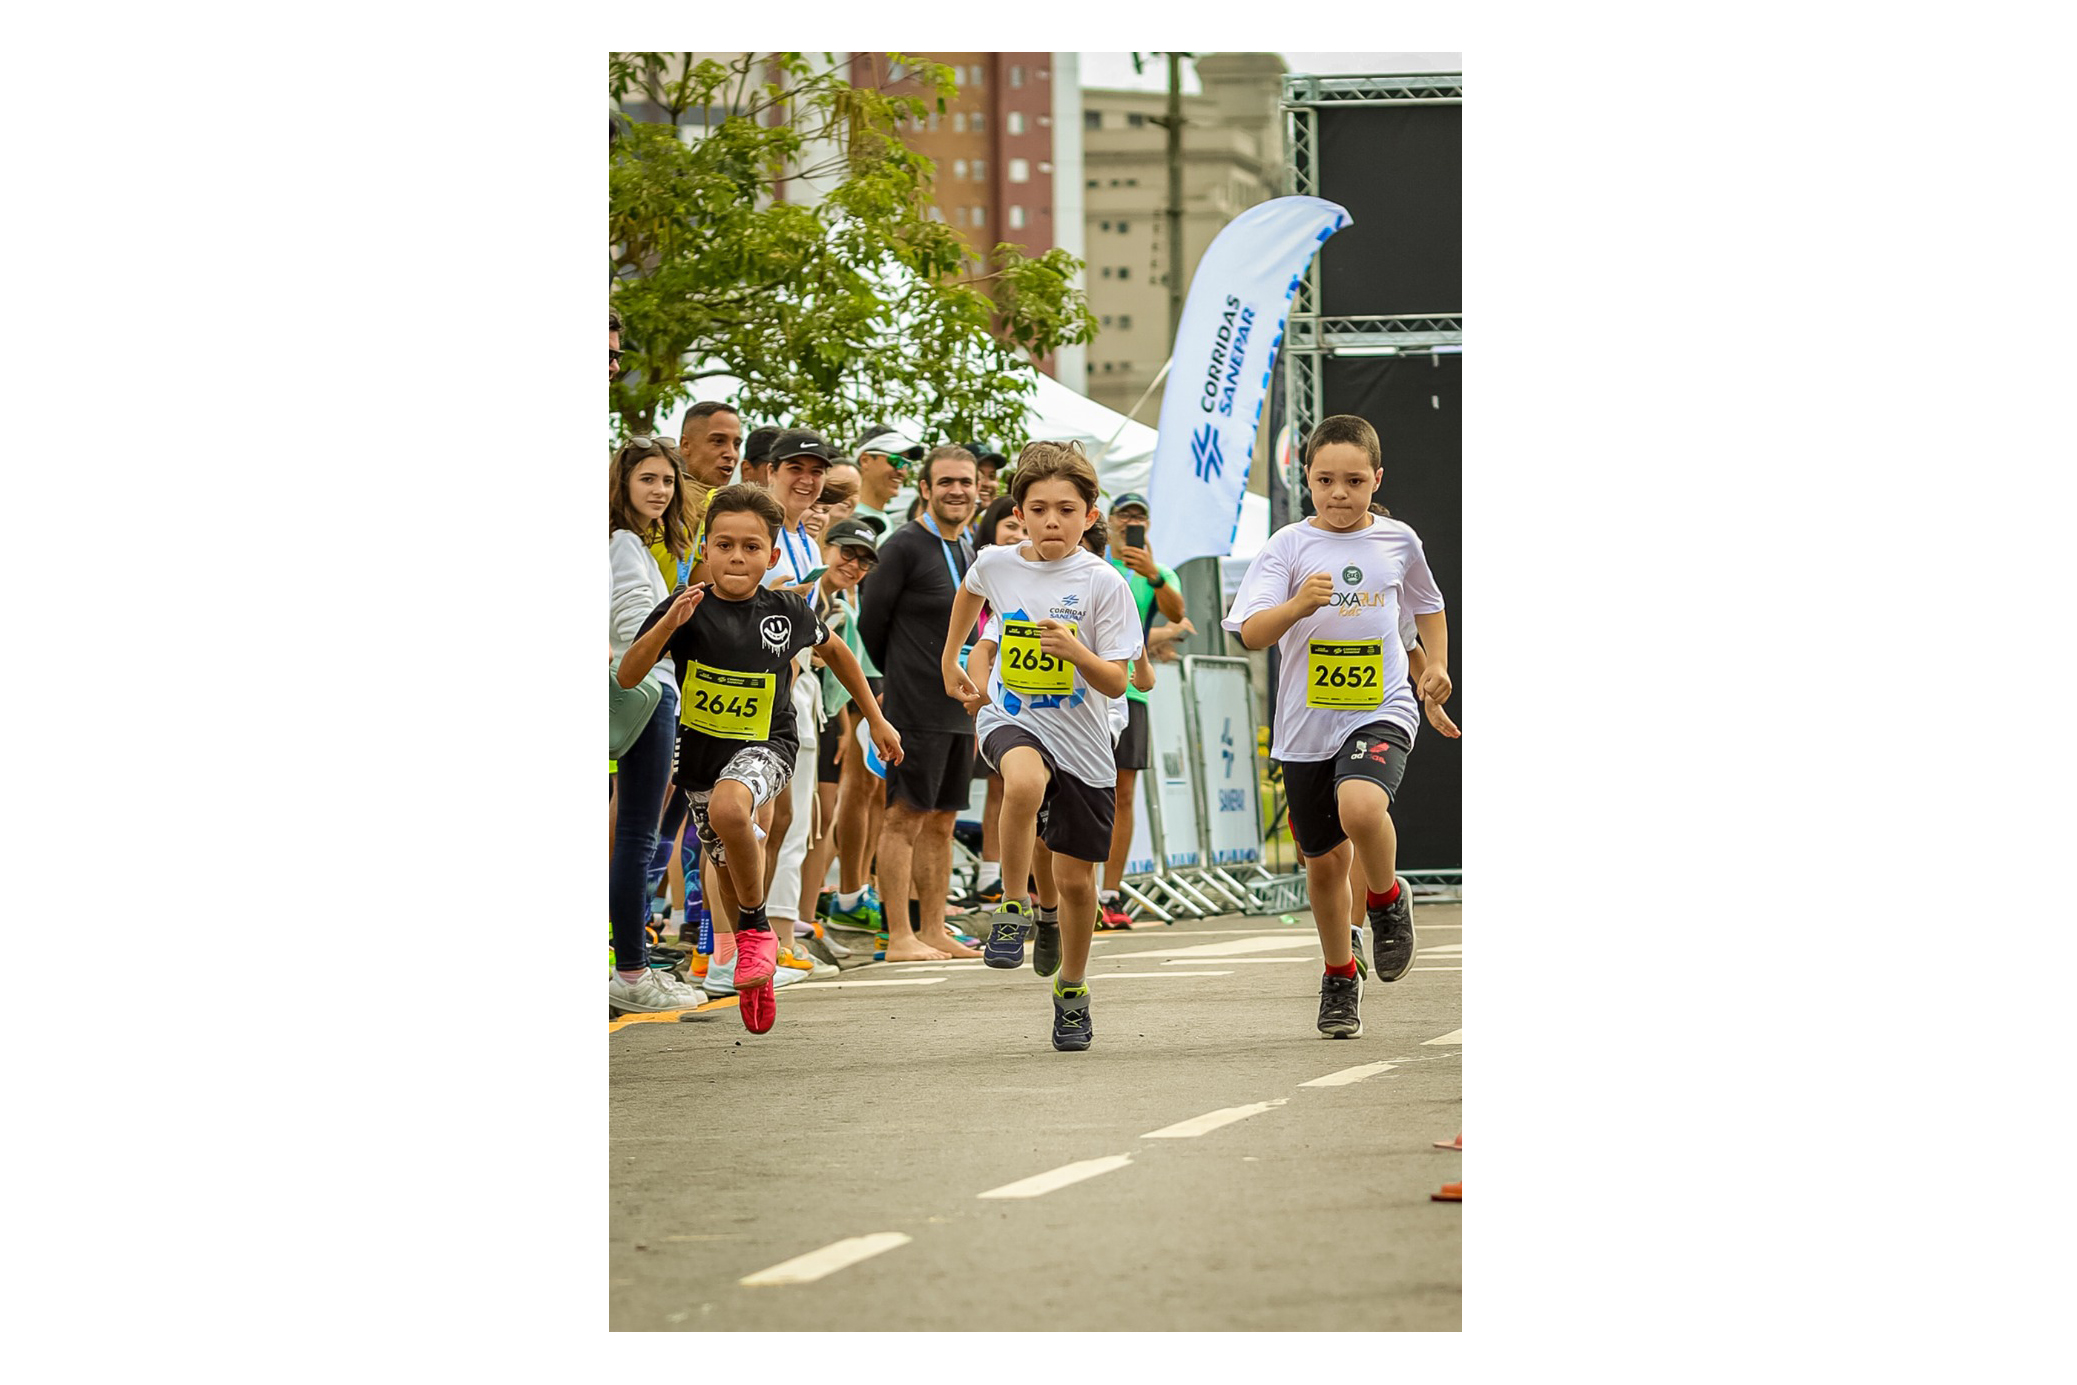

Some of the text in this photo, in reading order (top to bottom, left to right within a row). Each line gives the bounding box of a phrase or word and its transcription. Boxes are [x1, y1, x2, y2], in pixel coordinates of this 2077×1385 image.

[1201, 294, 1240, 413] CORRIDAS
[1219, 306, 1255, 417] SANEPAR
[1049, 607, 1087, 617] CORRIDAS
[1328, 592, 1385, 607] OXARUN
[1008, 647, 1063, 672] 2651
[1314, 664, 1377, 688] 2652
[694, 690, 758, 718] 2645
